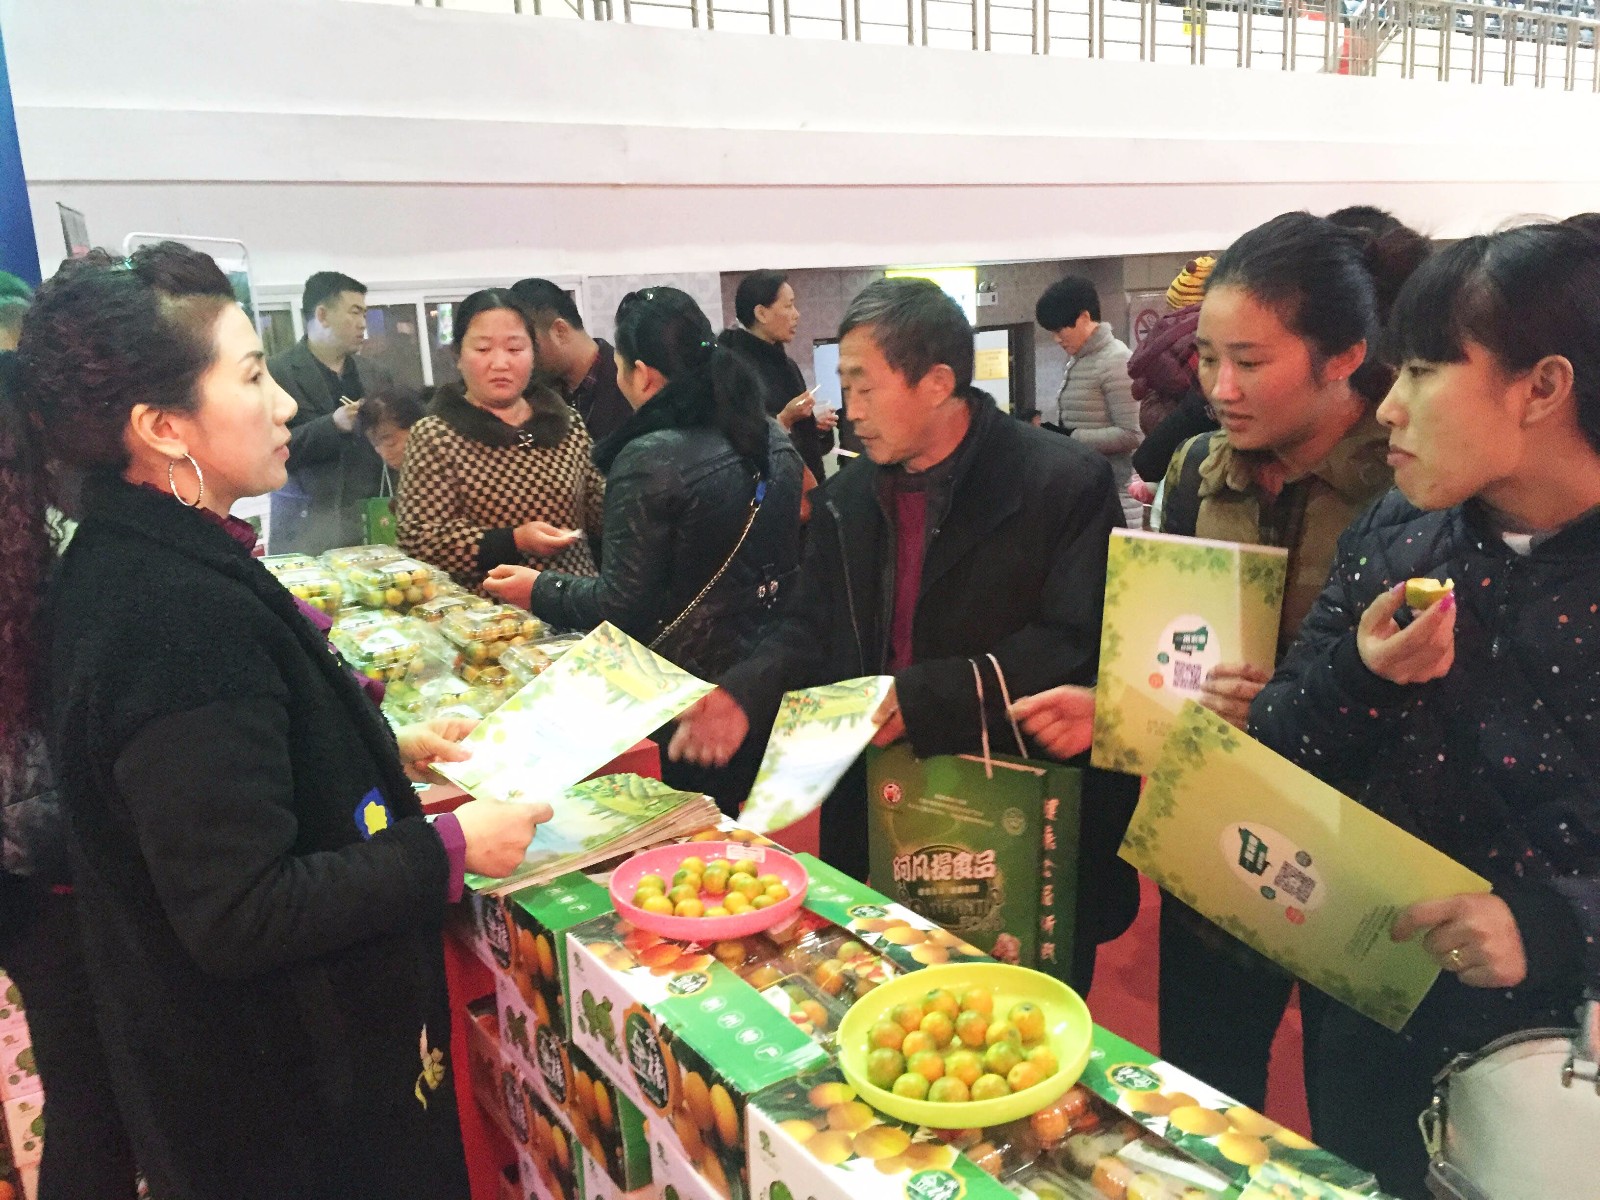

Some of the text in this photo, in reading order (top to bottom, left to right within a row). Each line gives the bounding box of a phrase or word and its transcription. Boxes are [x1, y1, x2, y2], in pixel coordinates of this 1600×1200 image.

[893, 849, 997, 882] 阿凡提食品
